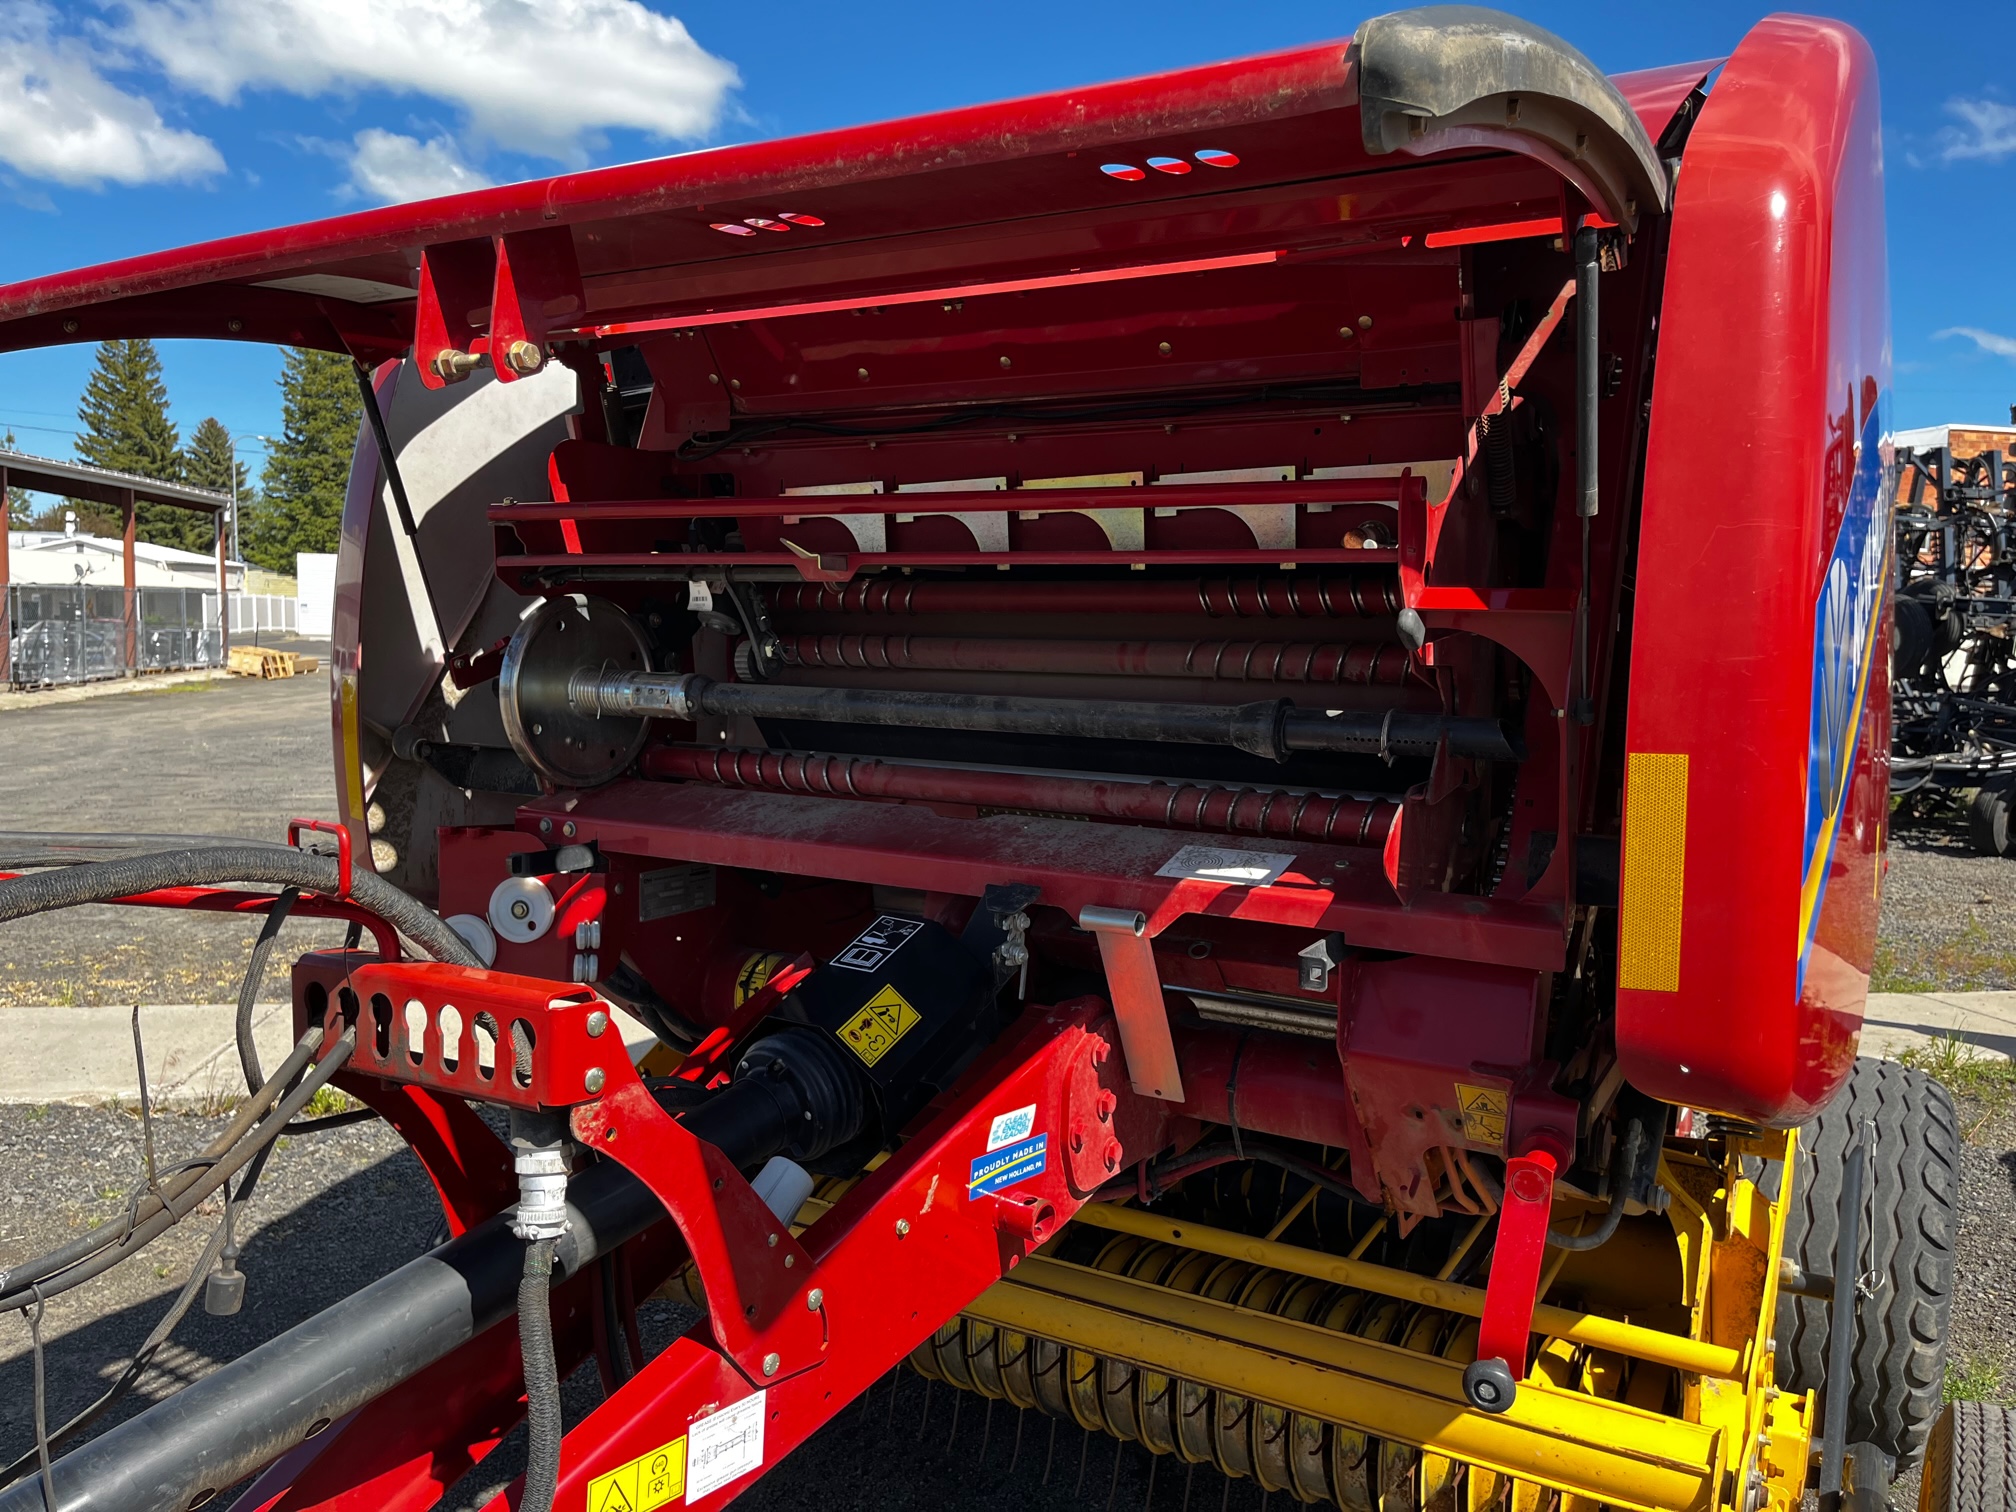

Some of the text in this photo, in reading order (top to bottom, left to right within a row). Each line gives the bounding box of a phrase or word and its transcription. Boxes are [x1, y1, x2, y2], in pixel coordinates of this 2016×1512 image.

[1002, 1117, 1032, 1134] ENERGY
[1004, 1111, 1029, 1125] CLEAN
[1000, 1125, 1029, 1141] LEADER
[973, 1141, 1044, 1180] PROUDLY MADE IN
[994, 1174, 1008, 1184] NEW
[1035, 1160, 1042, 1168] PA
